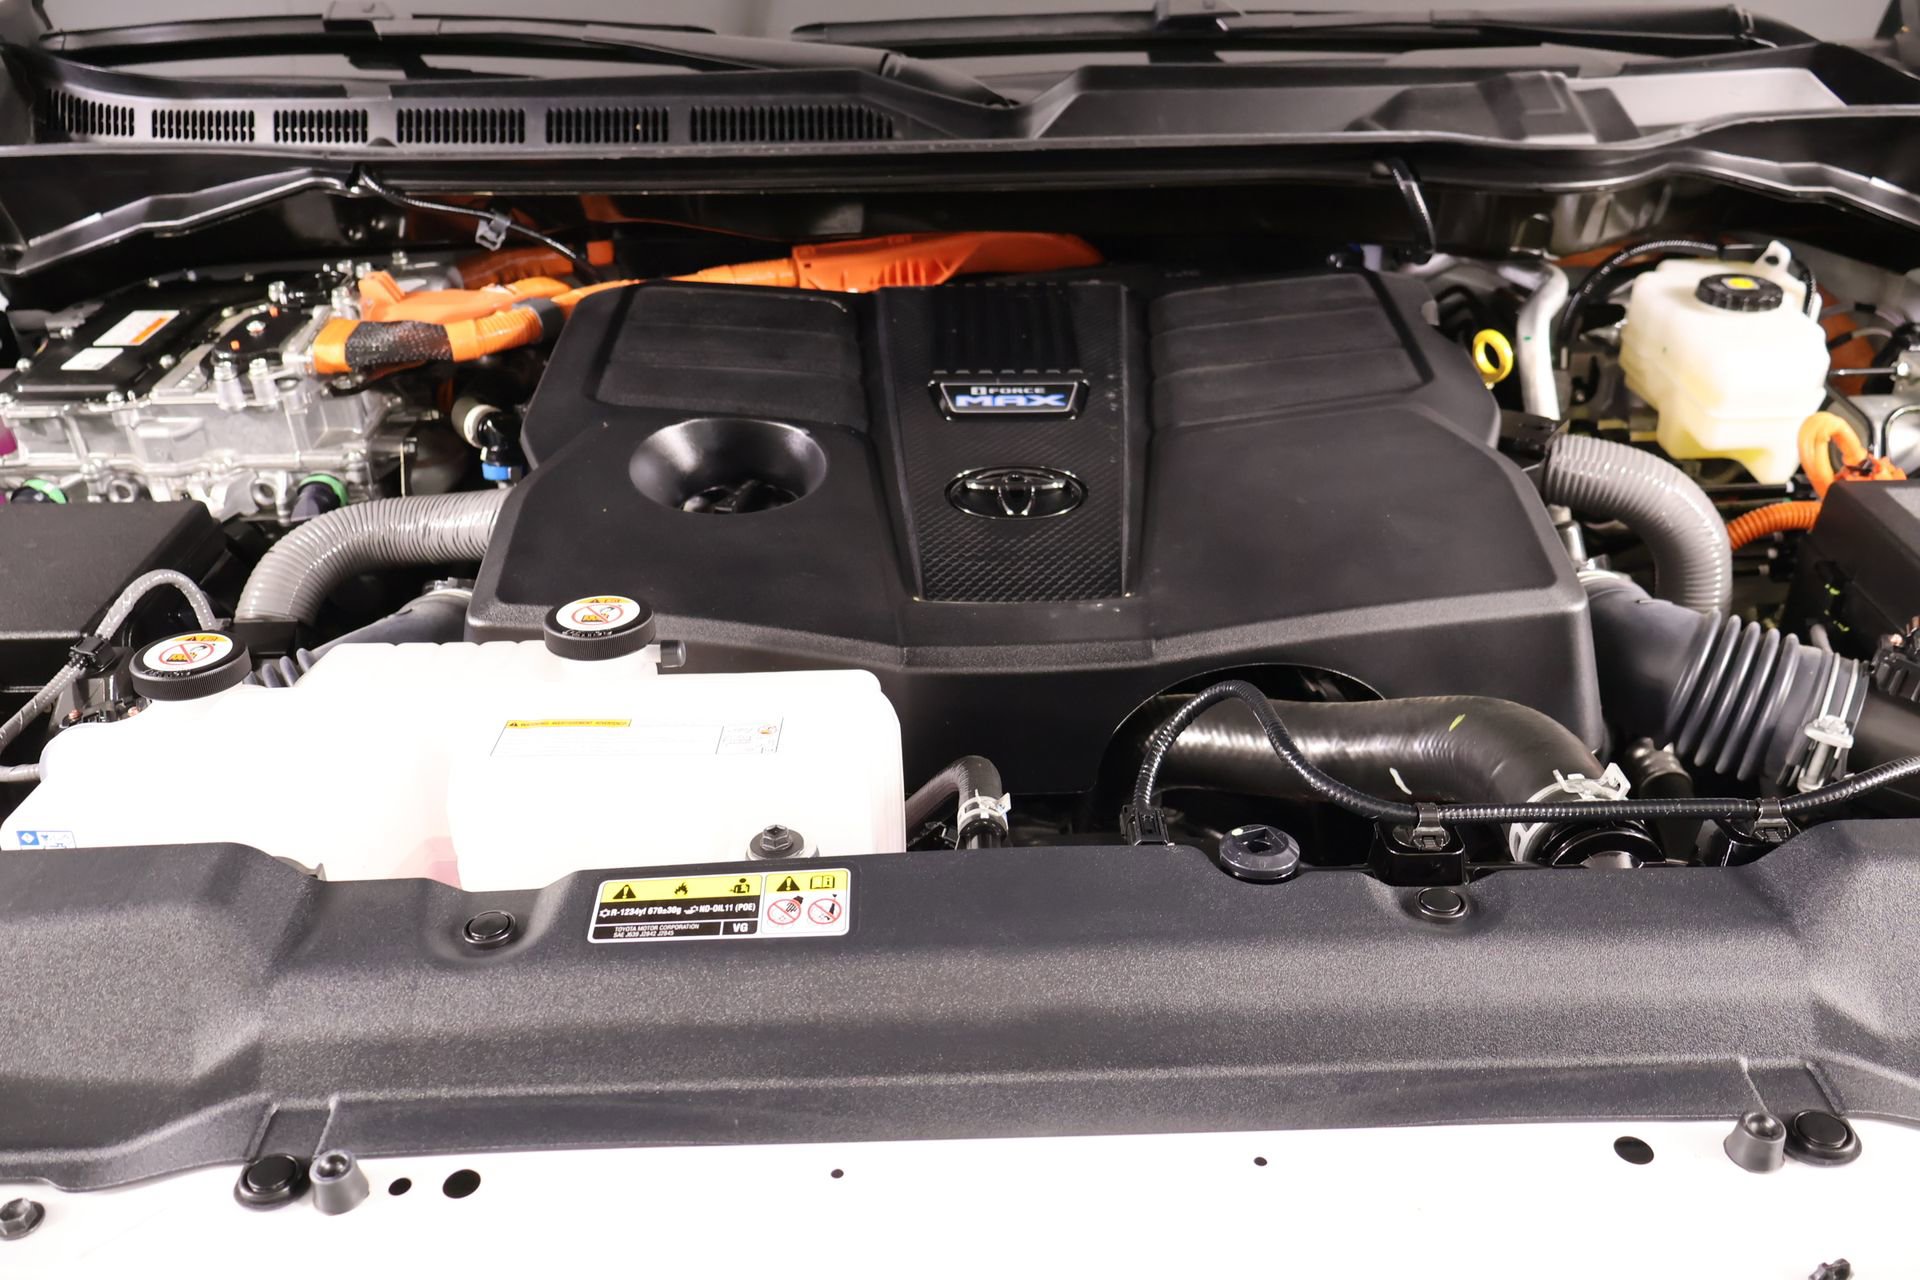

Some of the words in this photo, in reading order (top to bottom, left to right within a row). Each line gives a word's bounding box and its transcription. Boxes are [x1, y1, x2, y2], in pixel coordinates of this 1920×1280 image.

[955, 394, 1066, 406] MAX
[611, 907, 647, 917] R-1234yf
[735, 902, 756, 913] (POE)
[659, 923, 700, 931] CORPORATION
[733, 922, 749, 933] VG
[613, 931, 625, 939] SAE
